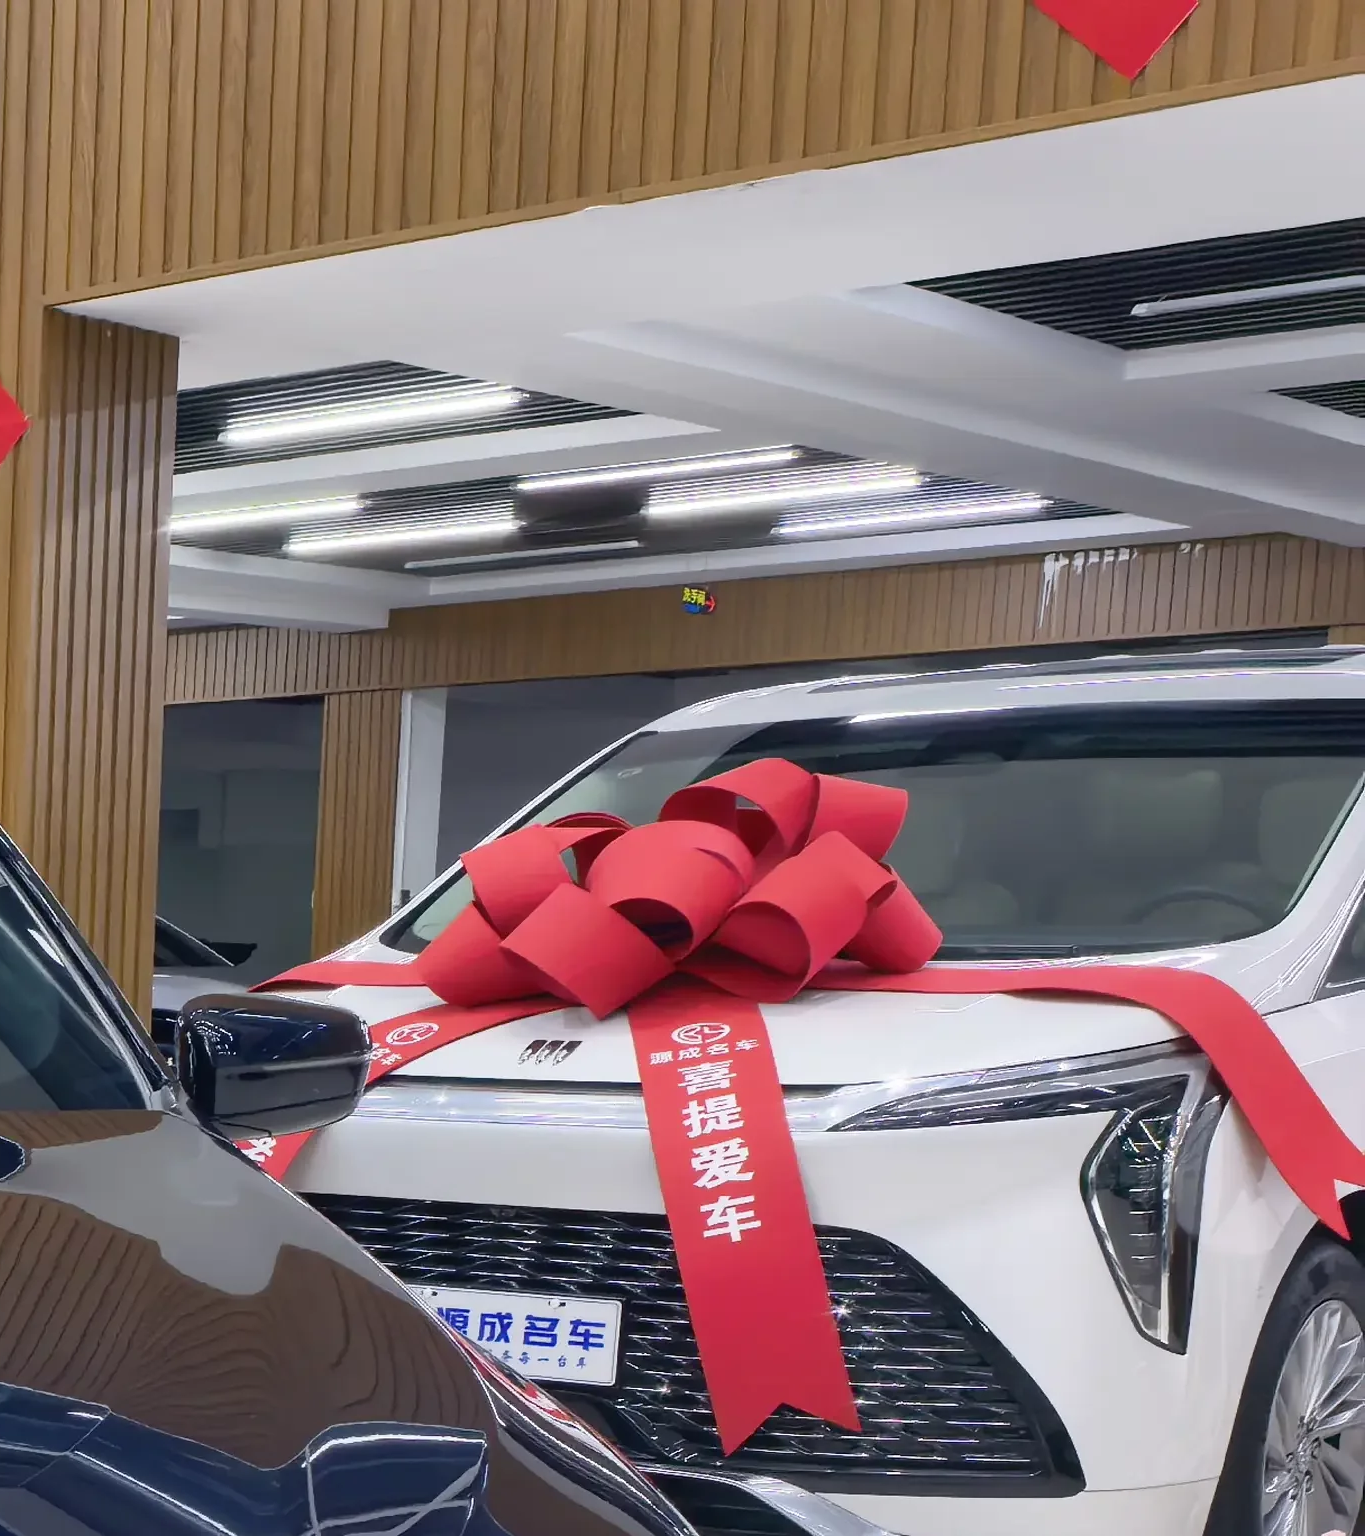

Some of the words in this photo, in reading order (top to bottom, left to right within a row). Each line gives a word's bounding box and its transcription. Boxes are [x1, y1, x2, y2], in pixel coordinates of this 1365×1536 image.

[650, 1040, 760, 1065] 源成名车
[677, 1060, 762, 1243] 喜提爱车
